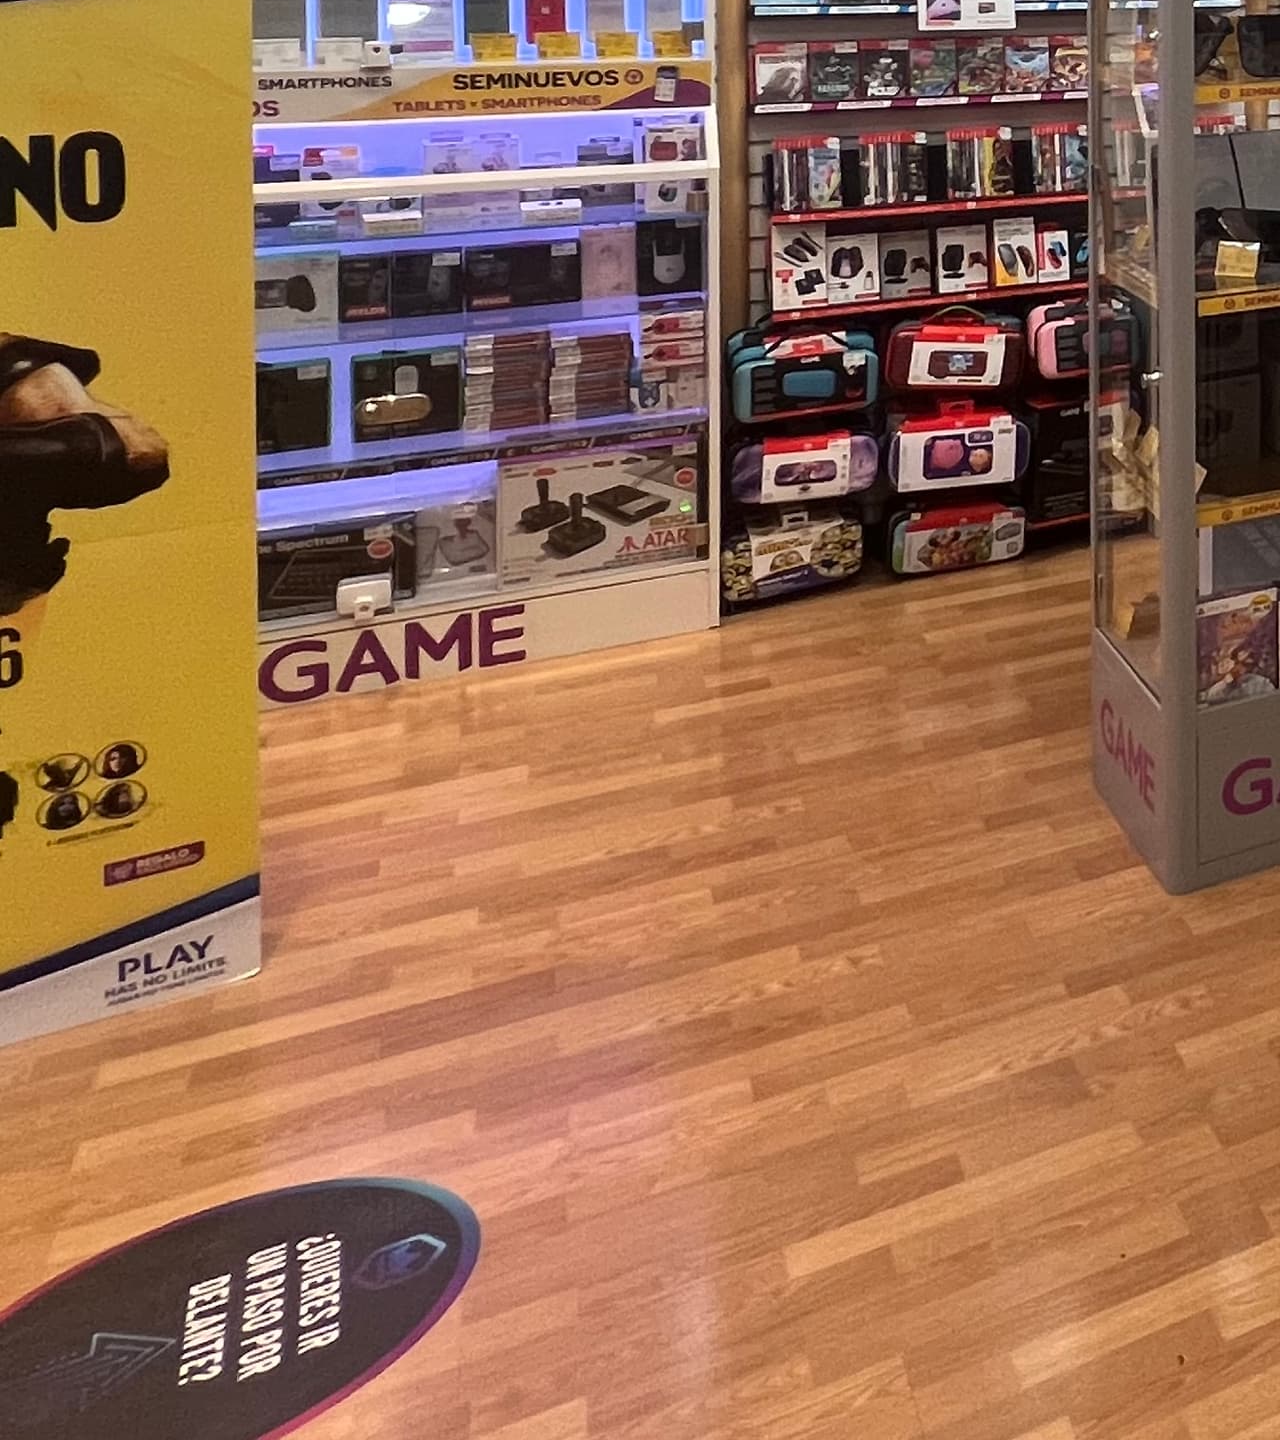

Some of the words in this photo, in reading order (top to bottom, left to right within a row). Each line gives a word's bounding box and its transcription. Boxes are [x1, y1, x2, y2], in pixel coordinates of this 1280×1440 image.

[258, 76, 393, 91] SMARTPHONES
[453, 70, 619, 92] SEMINUEVOS
[393, 100, 466, 112] TABLETS
[481, 95, 602, 110] SMARTPHONES
[276, 534, 349, 552] Spectrum
[642, 527, 691, 549] ATAR
[258, 605, 527, 703] GAME
[1100, 698, 1155, 814] GAME
[118, 935, 214, 982] PLAY
[142, 974, 168, 988] NO
[172, 957, 226, 979] LIMITS
[247, 1243, 288, 1280] UN
[295, 1233, 342, 1327] ¿QUIERES
[241, 1271, 287, 1334] PASO
[178, 1274, 233, 1387] DELANTE?
[297, 1318, 341, 1356] IR
[236, 1327, 283, 1383] POR
